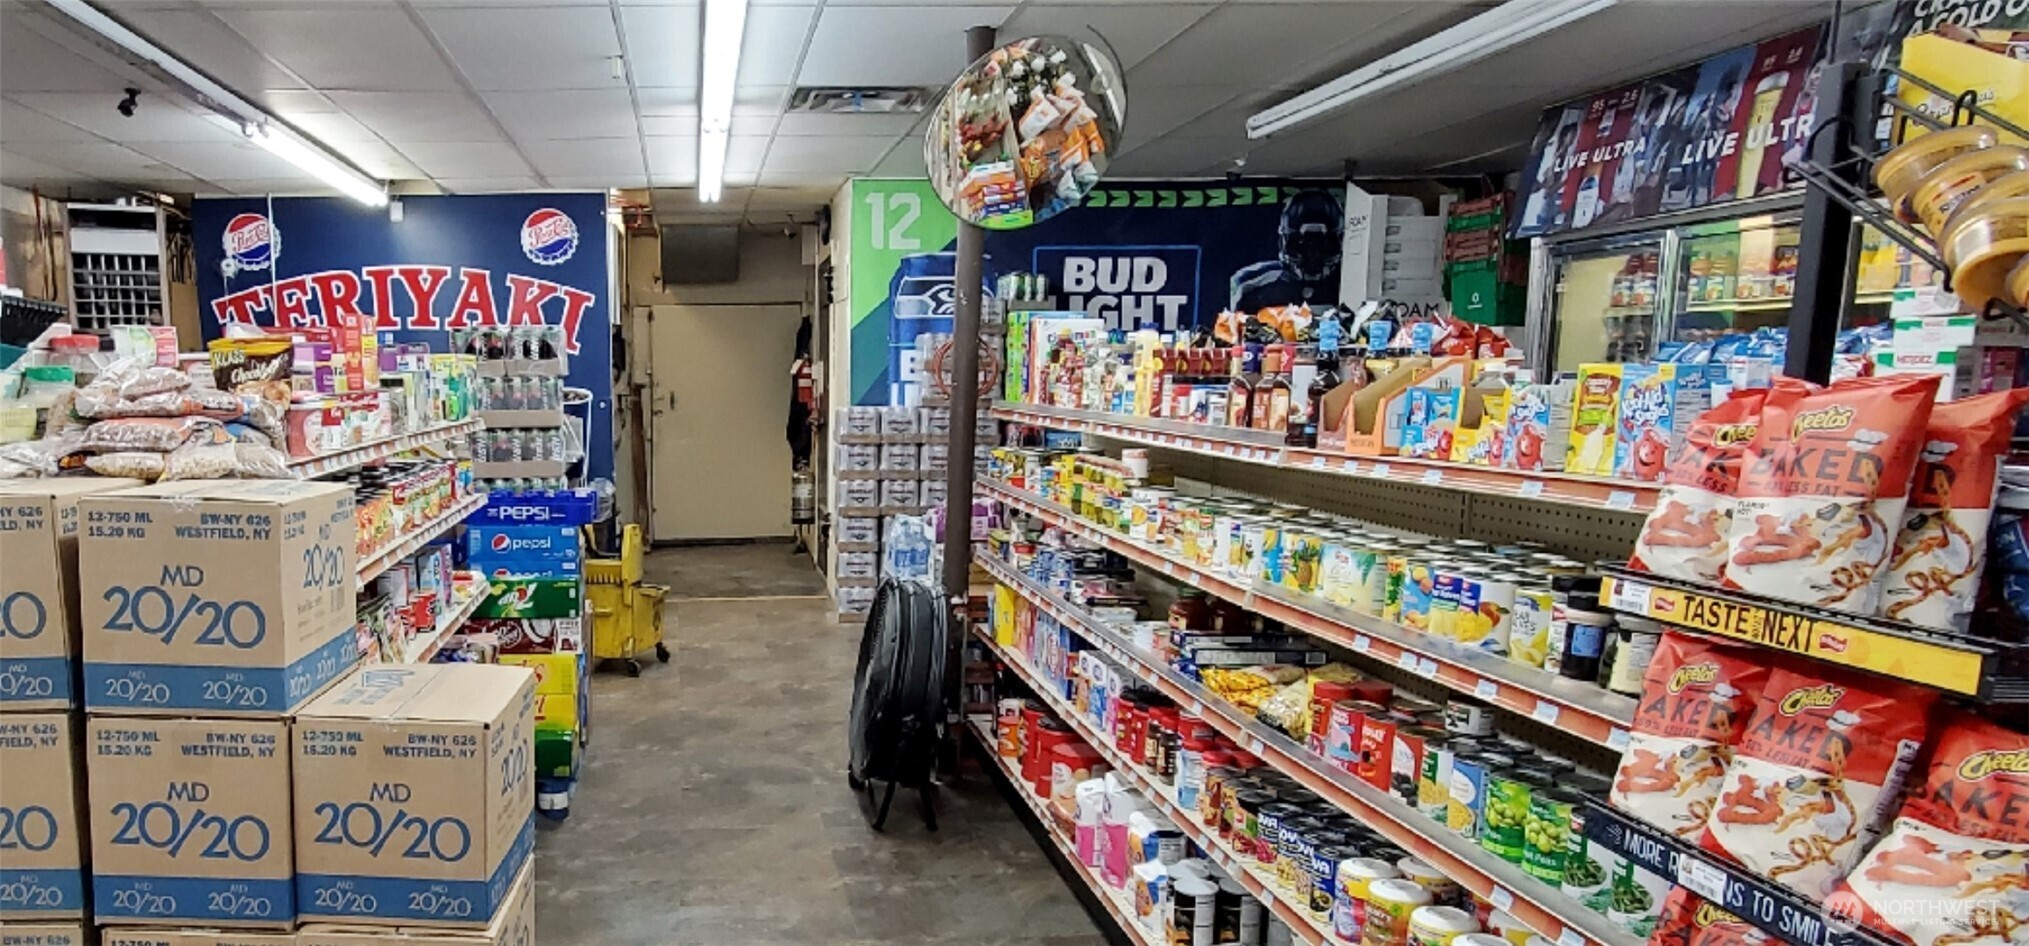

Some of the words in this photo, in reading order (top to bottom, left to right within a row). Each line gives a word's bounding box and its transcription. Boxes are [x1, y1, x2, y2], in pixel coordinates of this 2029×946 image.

[1681, 132, 1740, 166] LIVE
[1746, 112, 1813, 149] ULTR
[1554, 151, 1589, 173] LIVE
[1592, 136, 1647, 163] ULTRA
[865, 192, 921, 249] 12
[1063, 256, 1168, 293] BUD
[212, 265, 596, 355] TERIYAKI
[1398, 302, 1440, 318] OAM
[1714, 425, 1758, 446] Chee
[1792, 406, 1854, 444] eetos
[18, 506, 43, 517] 626
[88, 511, 130, 523] 12-750
[135, 512, 153, 523] ML
[200, 514, 242, 526] BW-NY
[246, 515, 272, 526] 626
[500, 506, 550, 520] PEPSI
[26, 520, 43, 529] NY
[88, 526, 124, 538] 15.20
[127, 527, 146, 538] KG
[175, 526, 250, 540] WESTFIELD,
[253, 527, 272, 540] NY
[513, 536, 551, 550] pepsi
[160, 565, 204, 587] MD
[102, 585, 266, 649] 20/20
[1683, 595, 1751, 634] TASTE
[1762, 611, 1818, 653] NEXT
[105, 677, 170, 703] 20/20
[1668, 663, 1720, 694] Cheetos
[202, 681, 267, 706] 20/20
[1780, 684, 1845, 716] Cheetos
[1643, 697, 1735, 732] AKED
[33, 724, 58, 735] 626
[40, 736, 58, 747] NY
[97, 730, 139, 742] 12-750
[142, 731, 161, 743] ML
[206, 733, 247, 744] BW-NY
[251, 734, 275, 745] 626
[303, 731, 343, 743] 12-750
[346, 732, 364, 742] ML
[408, 734, 448, 745] BW-NY
[453, 735, 477, 746] 626
[1750, 704, 1853, 761] AKED
[97, 745, 132, 756] 15.20
[135, 745, 152, 756] KG
[181, 745, 254, 758] WESTFIELD,
[258, 747, 276, 758] NY
[340, 745, 357, 756] KG
[383, 745, 456, 758] WESTFIELD,
[458, 747, 477, 758] NY
[1959, 751, 2029, 781] Cheeto
[167, 782, 210, 802] MD
[369, 782, 411, 802] MD
[1934, 779, 2029, 826] AKE
[110, 801, 270, 862] 20/20
[314, 802, 471, 862] 20/20
[1624, 829, 1665, 869] MORE
[1, 883, 63, 907] 20/20
[113, 890, 176, 915] 20/20
[208, 892, 272, 917] 20/20
[315, 888, 376, 914] 20/20
[409, 892, 471, 917] 20/20
[1753, 890, 1774, 923] TO
[1779, 905, 1838, 946] SMILE
